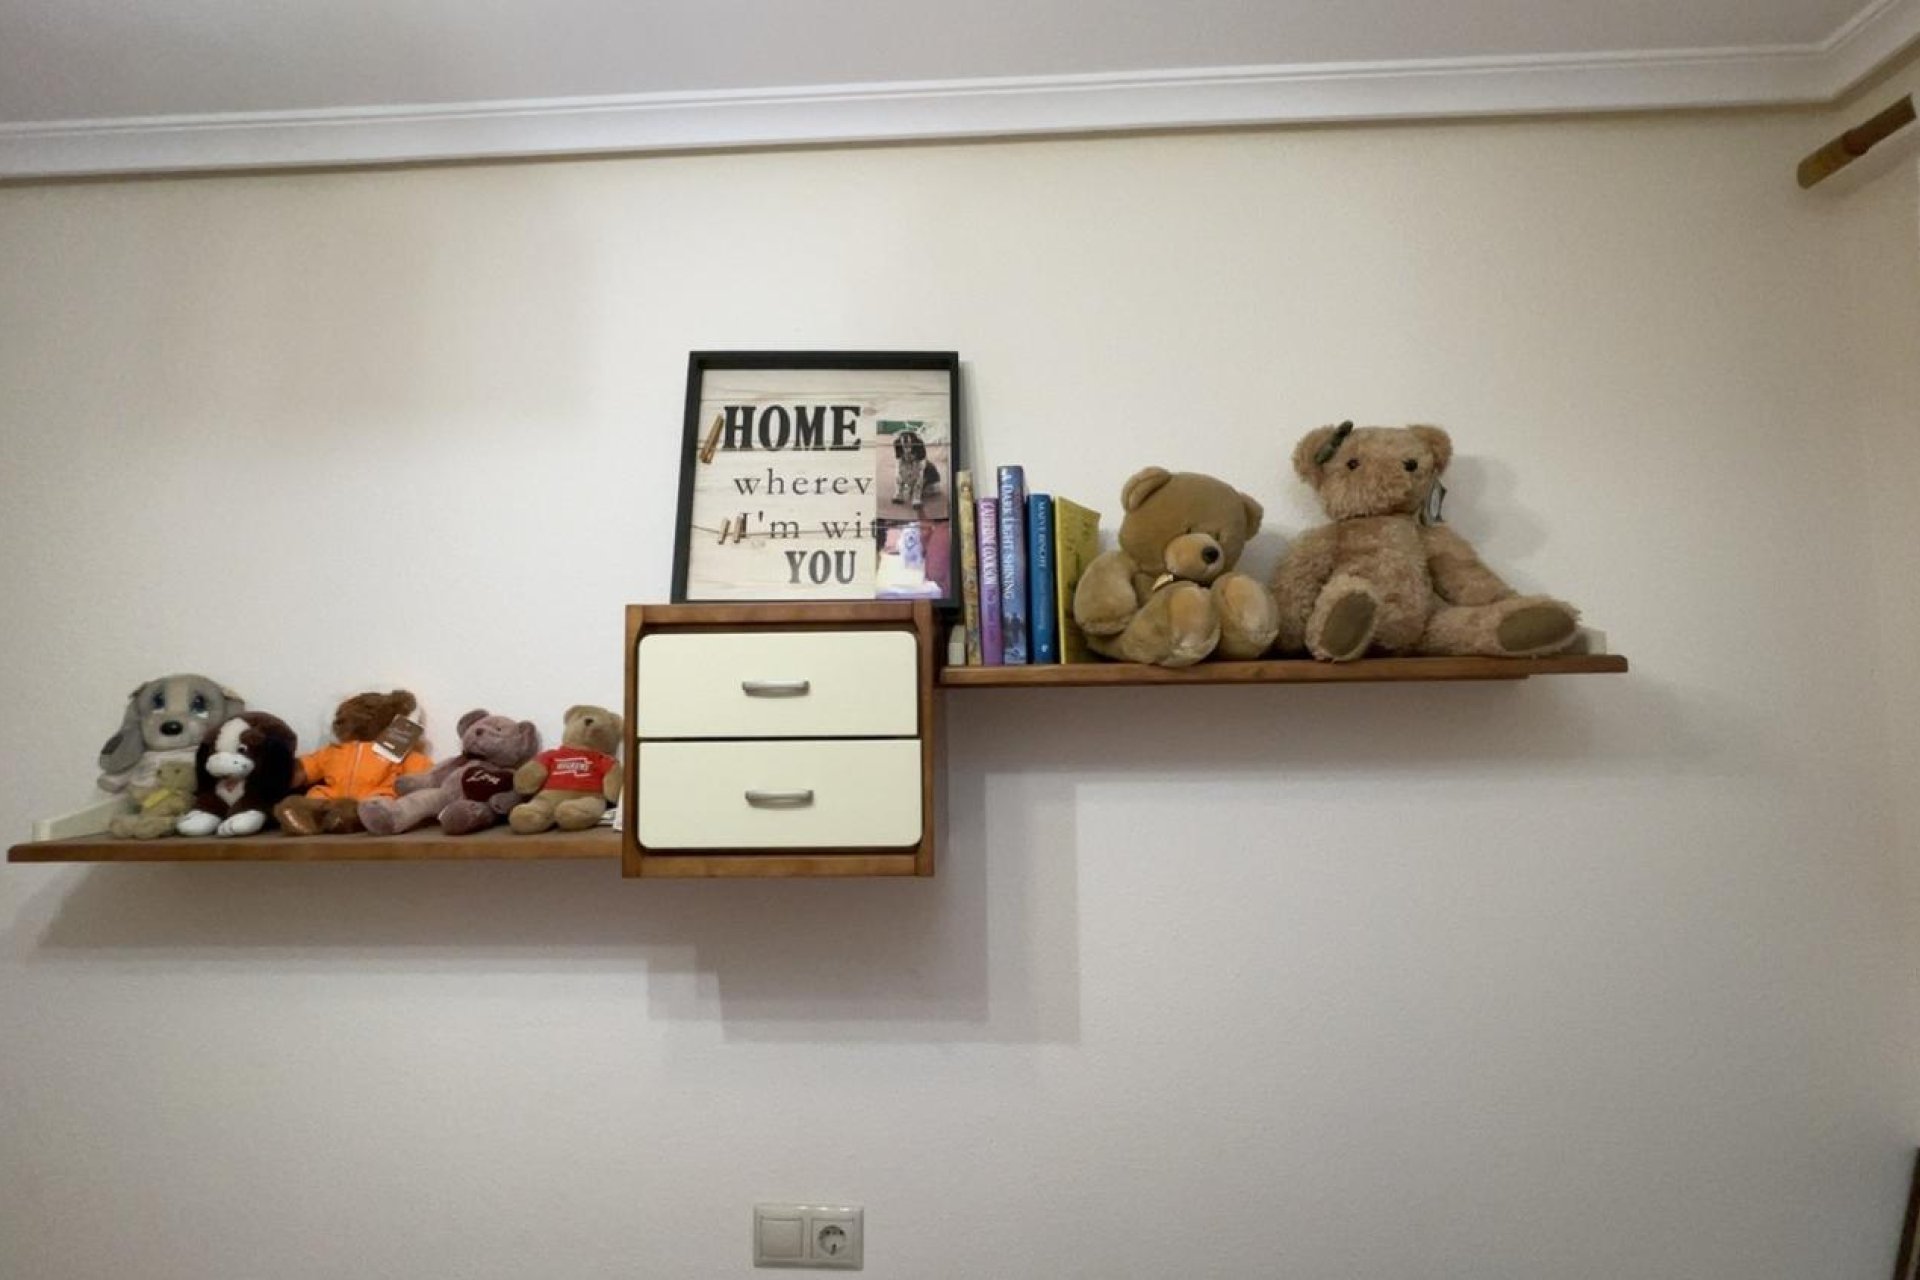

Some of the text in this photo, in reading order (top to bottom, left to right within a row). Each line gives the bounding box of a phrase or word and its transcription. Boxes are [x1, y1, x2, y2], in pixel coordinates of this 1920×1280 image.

[722, 404, 862, 452] HOME
[733, 468, 873, 496] wherev
[740, 510, 877, 539] I'm wit
[1001, 516, 1020, 551] LIGHT
[784, 549, 857, 584] YOU
[1003, 551, 1016, 600] SHINING
